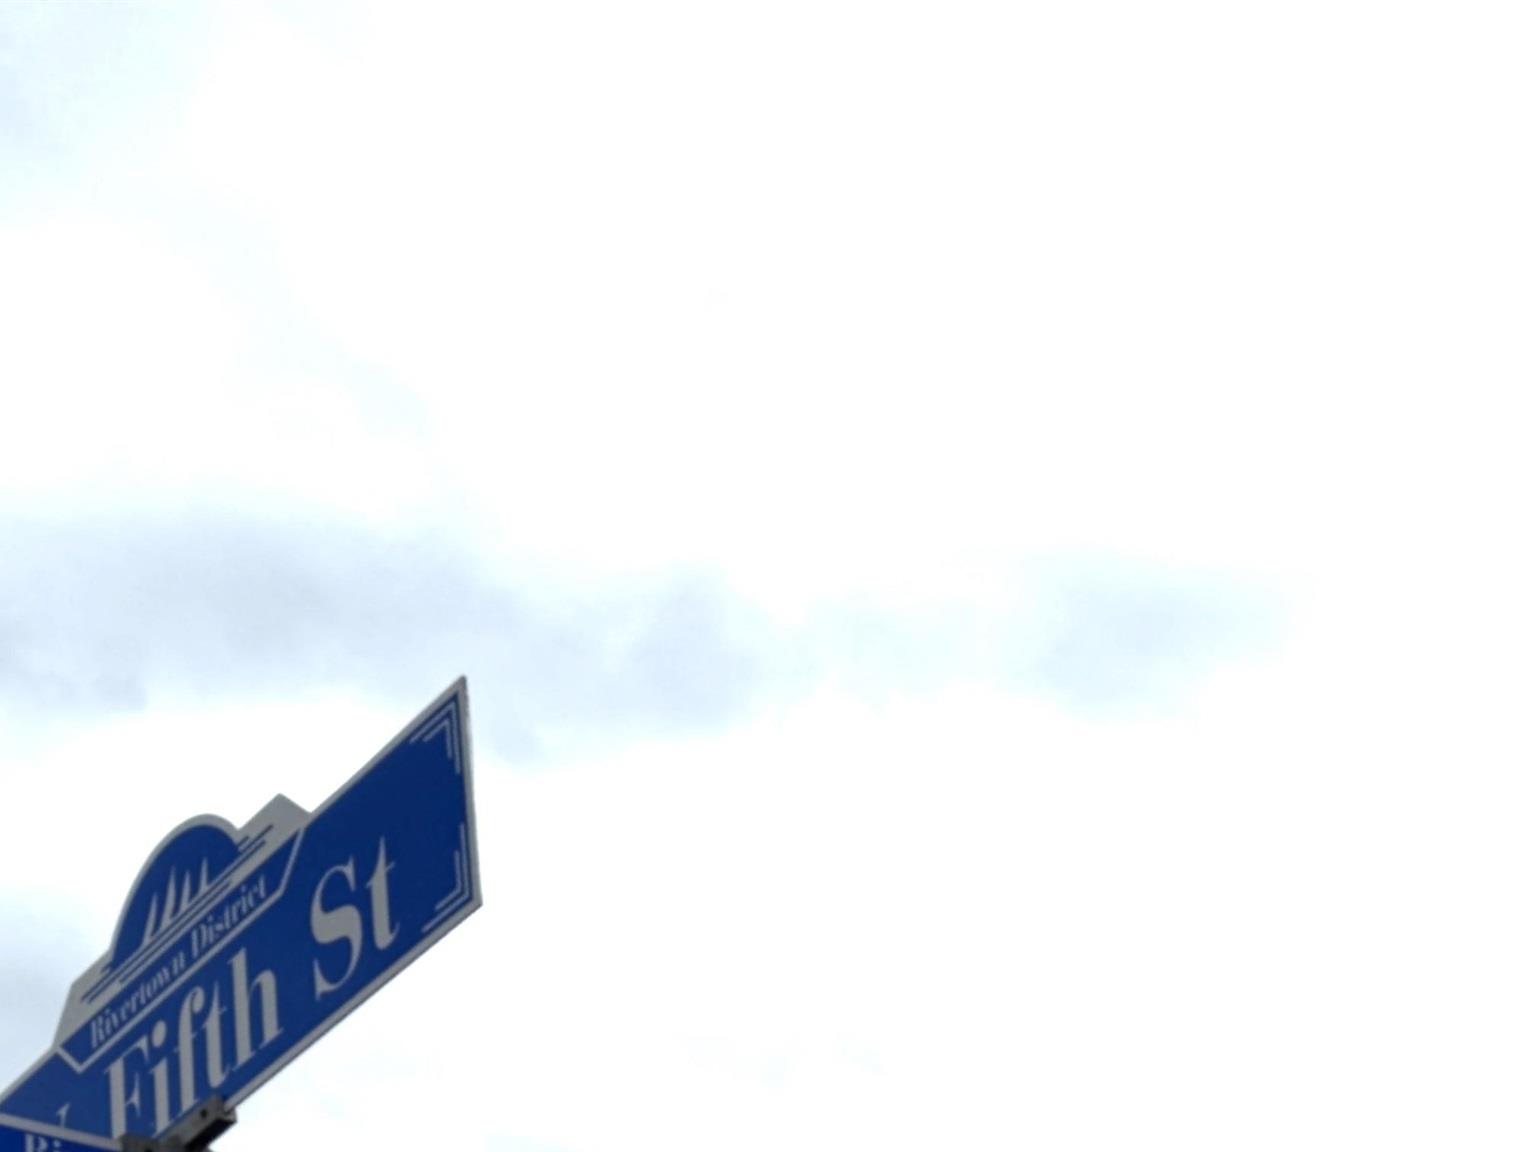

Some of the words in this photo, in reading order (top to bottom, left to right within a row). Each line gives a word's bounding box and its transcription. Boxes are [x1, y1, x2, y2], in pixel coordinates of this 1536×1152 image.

[88, 950, 186, 1049] Rivertown
[190, 874, 266, 959] District
[104, 946, 284, 1140] Fifth
[309, 835, 401, 1001] St
